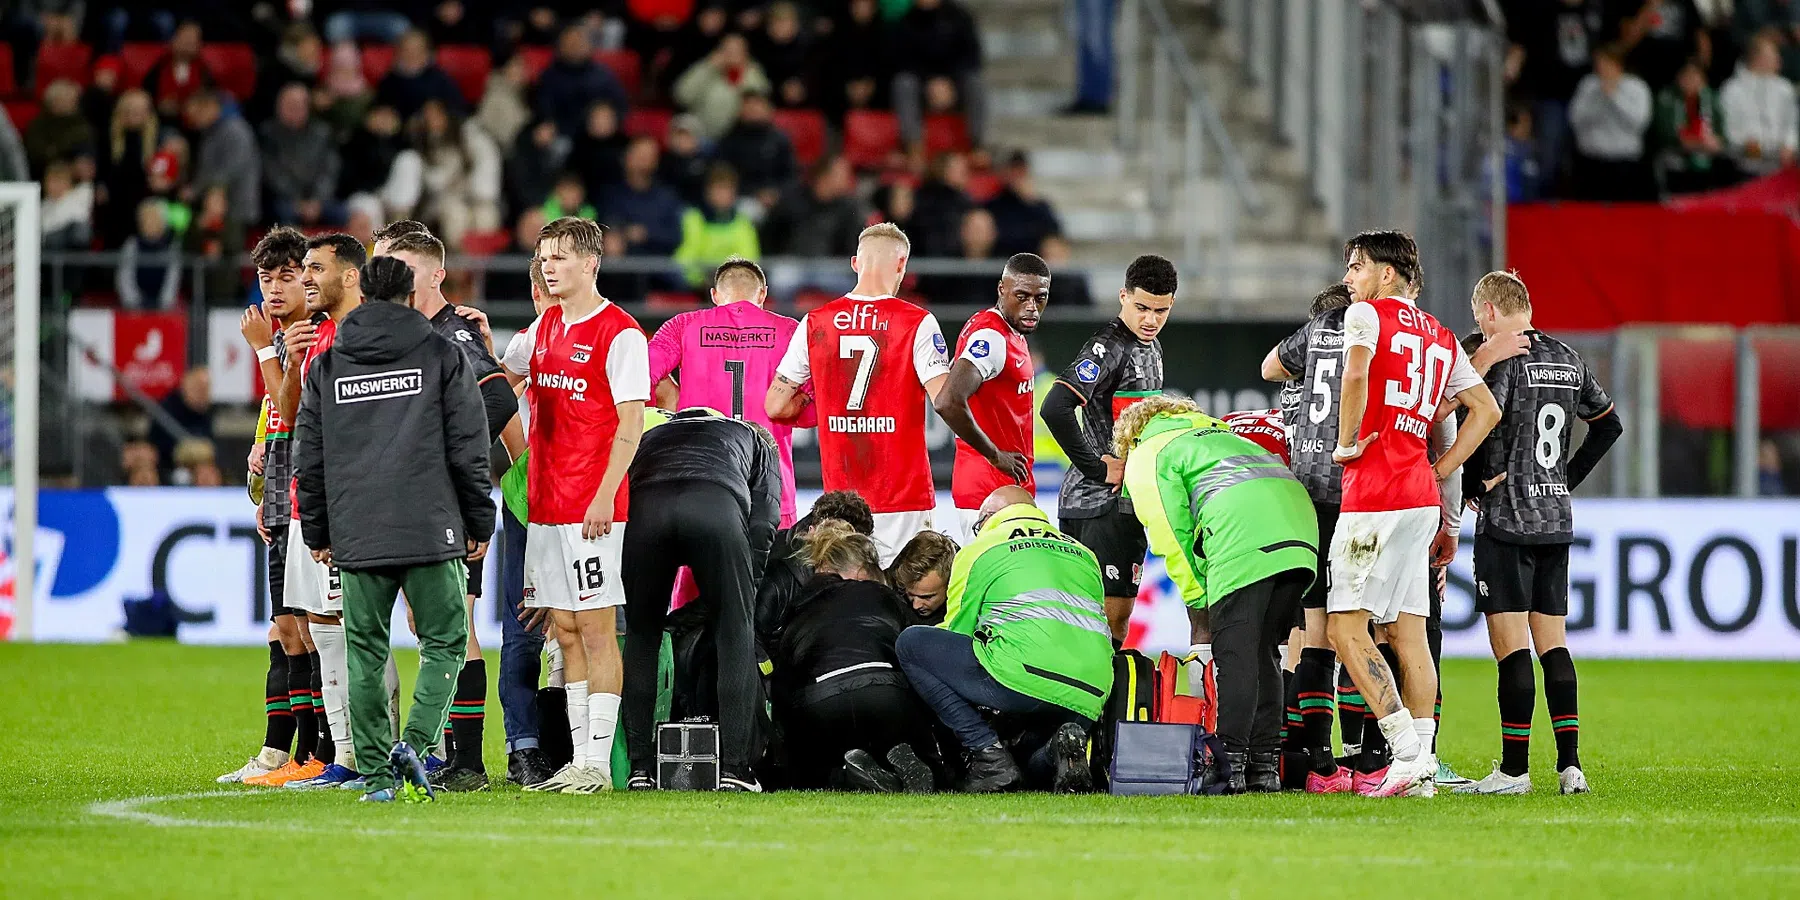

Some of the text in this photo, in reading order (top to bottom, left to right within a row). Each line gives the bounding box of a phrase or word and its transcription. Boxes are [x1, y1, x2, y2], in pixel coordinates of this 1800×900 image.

[341, 375, 423, 397] NASWERKT!
[724, 359, 745, 420] 1
[840, 335, 880, 410] 7
[1309, 358, 1338, 425] 5
[1384, 331, 1453, 422] 30
[828, 416, 896, 433] ODGAARD
[1301, 439, 1324, 453] BAAS
[1535, 403, 1566, 469] 8
[573, 556, 604, 591] 18
